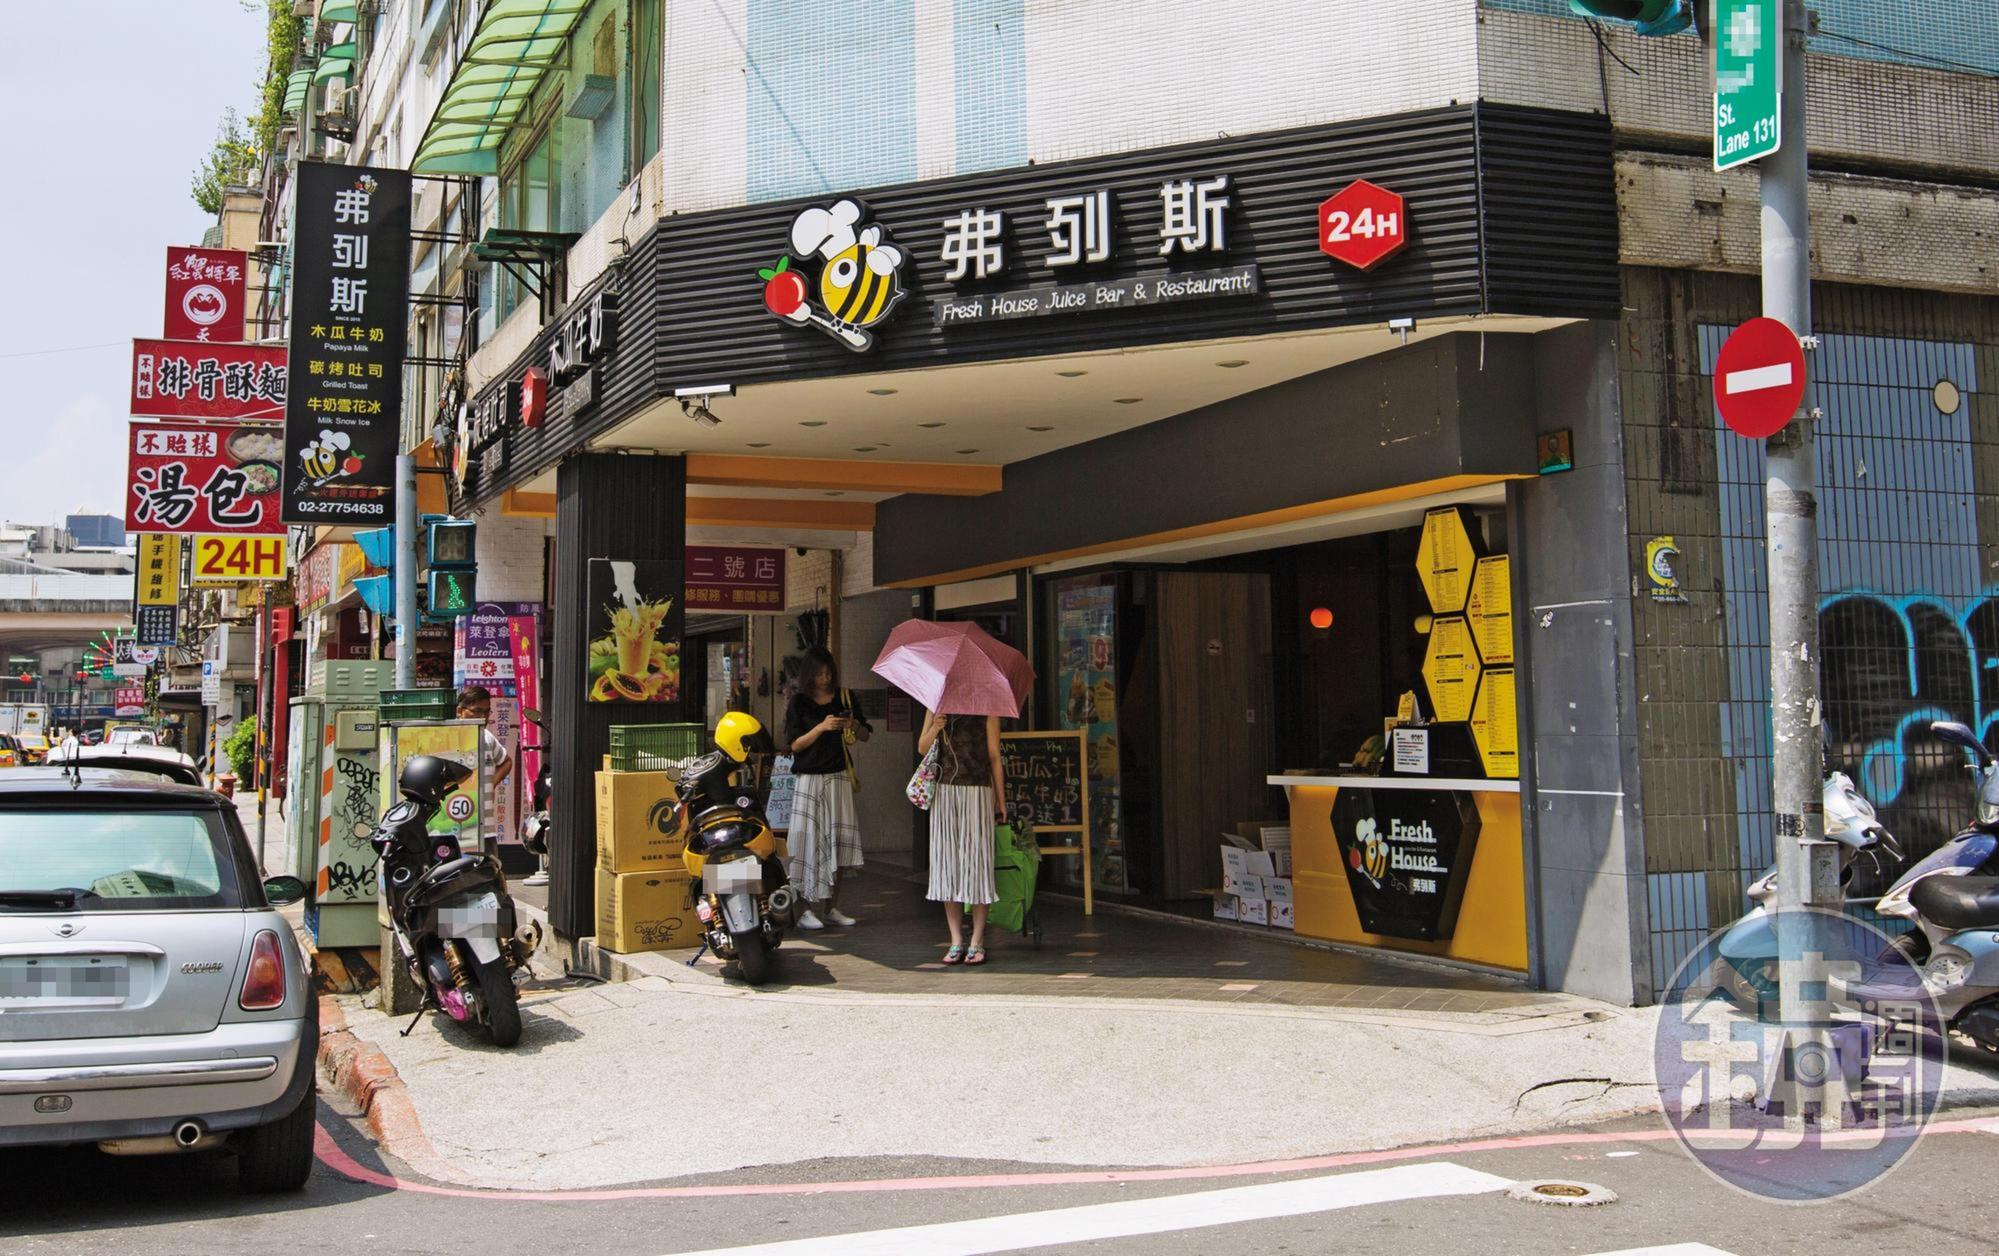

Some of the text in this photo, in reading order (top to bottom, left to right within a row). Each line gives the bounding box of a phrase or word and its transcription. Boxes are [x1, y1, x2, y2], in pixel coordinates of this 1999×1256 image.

[1718, 103, 1736, 128] St.
[1718, 114, 1776, 157] Lane 131
[941, 175, 1231, 281] 弗列斯
[1327, 207, 1398, 243] 24H
[330, 189, 370, 314] 弗列斯
[942, 271, 1251, 321] Fresh House Juice Bar & Restaurant
[310, 324, 384, 342] 木瓜牛奶
[323, 342, 369, 352] Papaya Milk
[158, 357, 287, 404] 排骨酥麵
[309, 360, 383, 378] 碳烤吐司
[322, 380, 368, 390] Grilled Toast
[307, 396, 382, 414] 牛奶雪花冰
[317, 416, 371, 426] Milk Snow Ice
[133, 462, 263, 527] 湯包
[298, 501, 384, 514] 02-27754638
[201, 539, 282, 575] 24H
[692, 555, 776, 580] 二號店
[451, 800, 470, 816] 50
[1390, 819, 1433, 842] Fresh
[1391, 846, 1438, 870] House
[181, 961, 224, 975] COOPER
